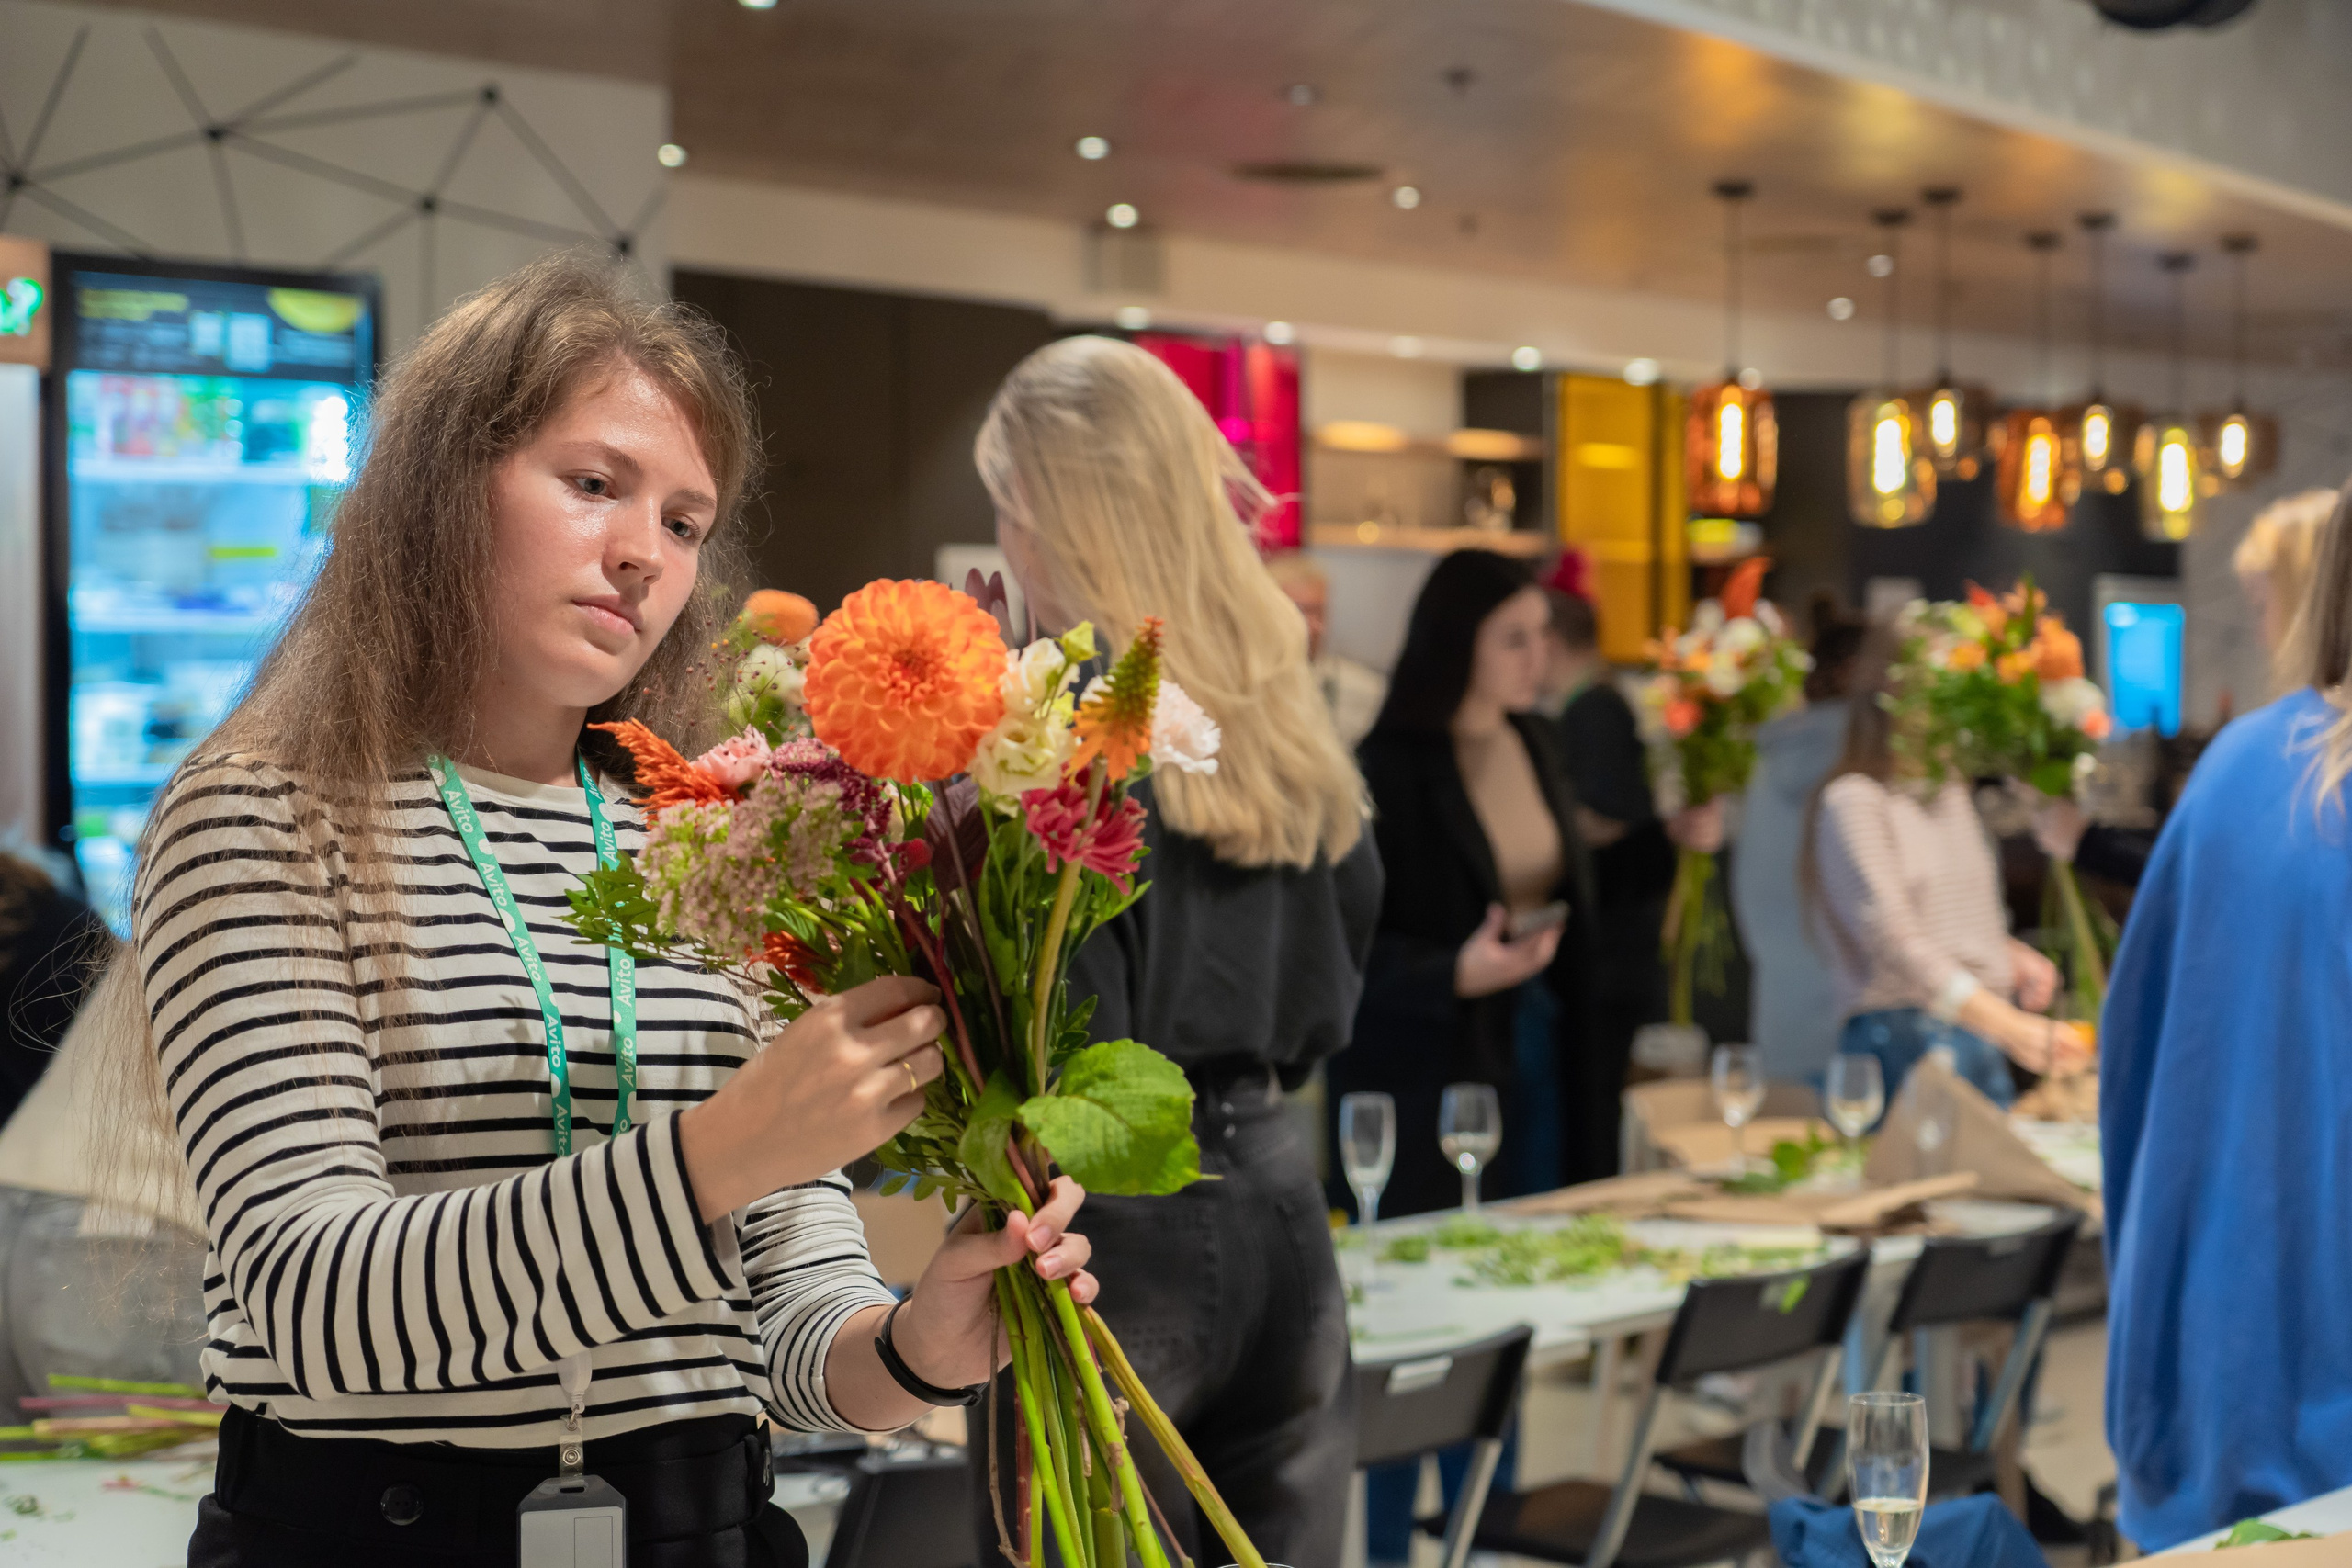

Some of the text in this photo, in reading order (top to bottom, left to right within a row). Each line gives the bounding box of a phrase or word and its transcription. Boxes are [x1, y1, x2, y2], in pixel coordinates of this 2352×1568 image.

[582, 766, 602, 800] Avito
[444, 789, 474, 833] Avito
[600, 821, 616, 863] Avito
[478, 862, 508, 907] Avito
[514, 935, 541, 982] Avito
[616, 958, 632, 1008] Avito
[545, 1013, 561, 1068] Avito
[620, 1037, 634, 1088] Avito
[555, 1103, 569, 1157] Avito
